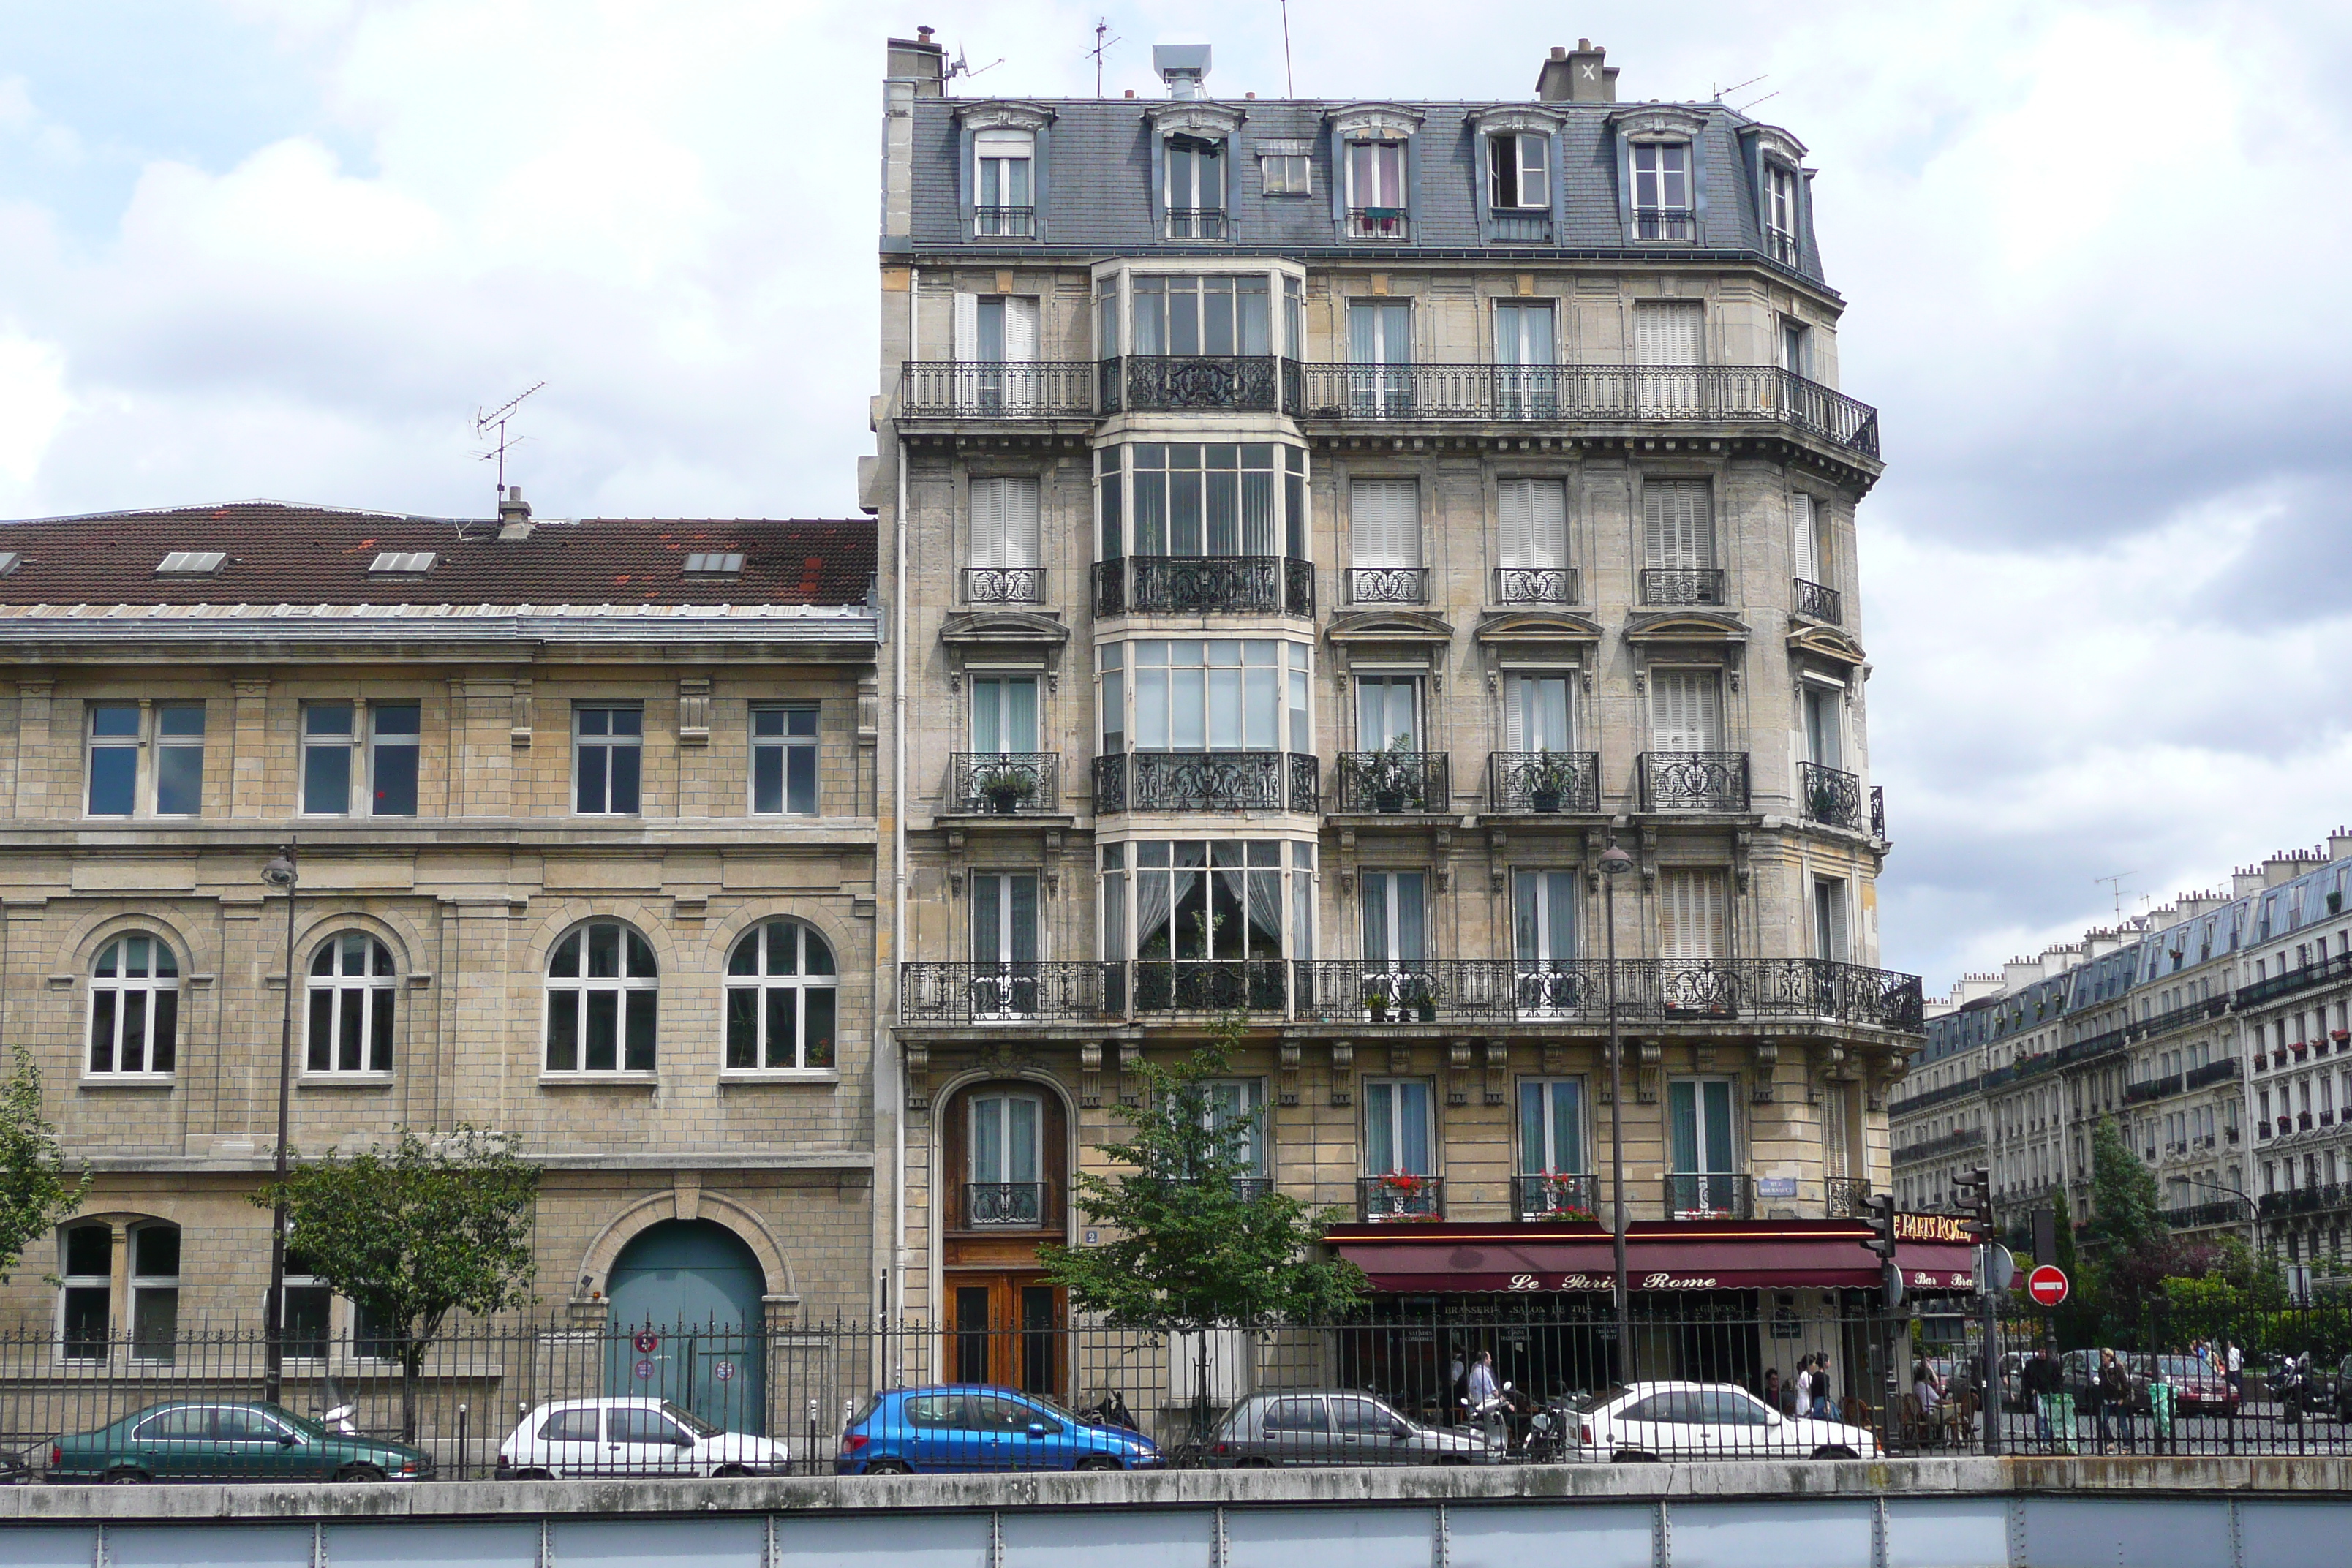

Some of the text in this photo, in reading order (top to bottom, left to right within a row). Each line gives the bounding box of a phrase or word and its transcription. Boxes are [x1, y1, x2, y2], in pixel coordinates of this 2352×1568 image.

[1893, 1215, 1900, 1239] E
[1901, 1213, 1936, 1240] PARIS
[1088, 1232, 1096, 1242] 2
[1508, 1274, 1540, 1289] Le
[1643, 1273, 1717, 1288] Rome
[1915, 1272, 1973, 1286] Bar Bra
[1444, 1305, 1501, 1314] BRASSERIE
